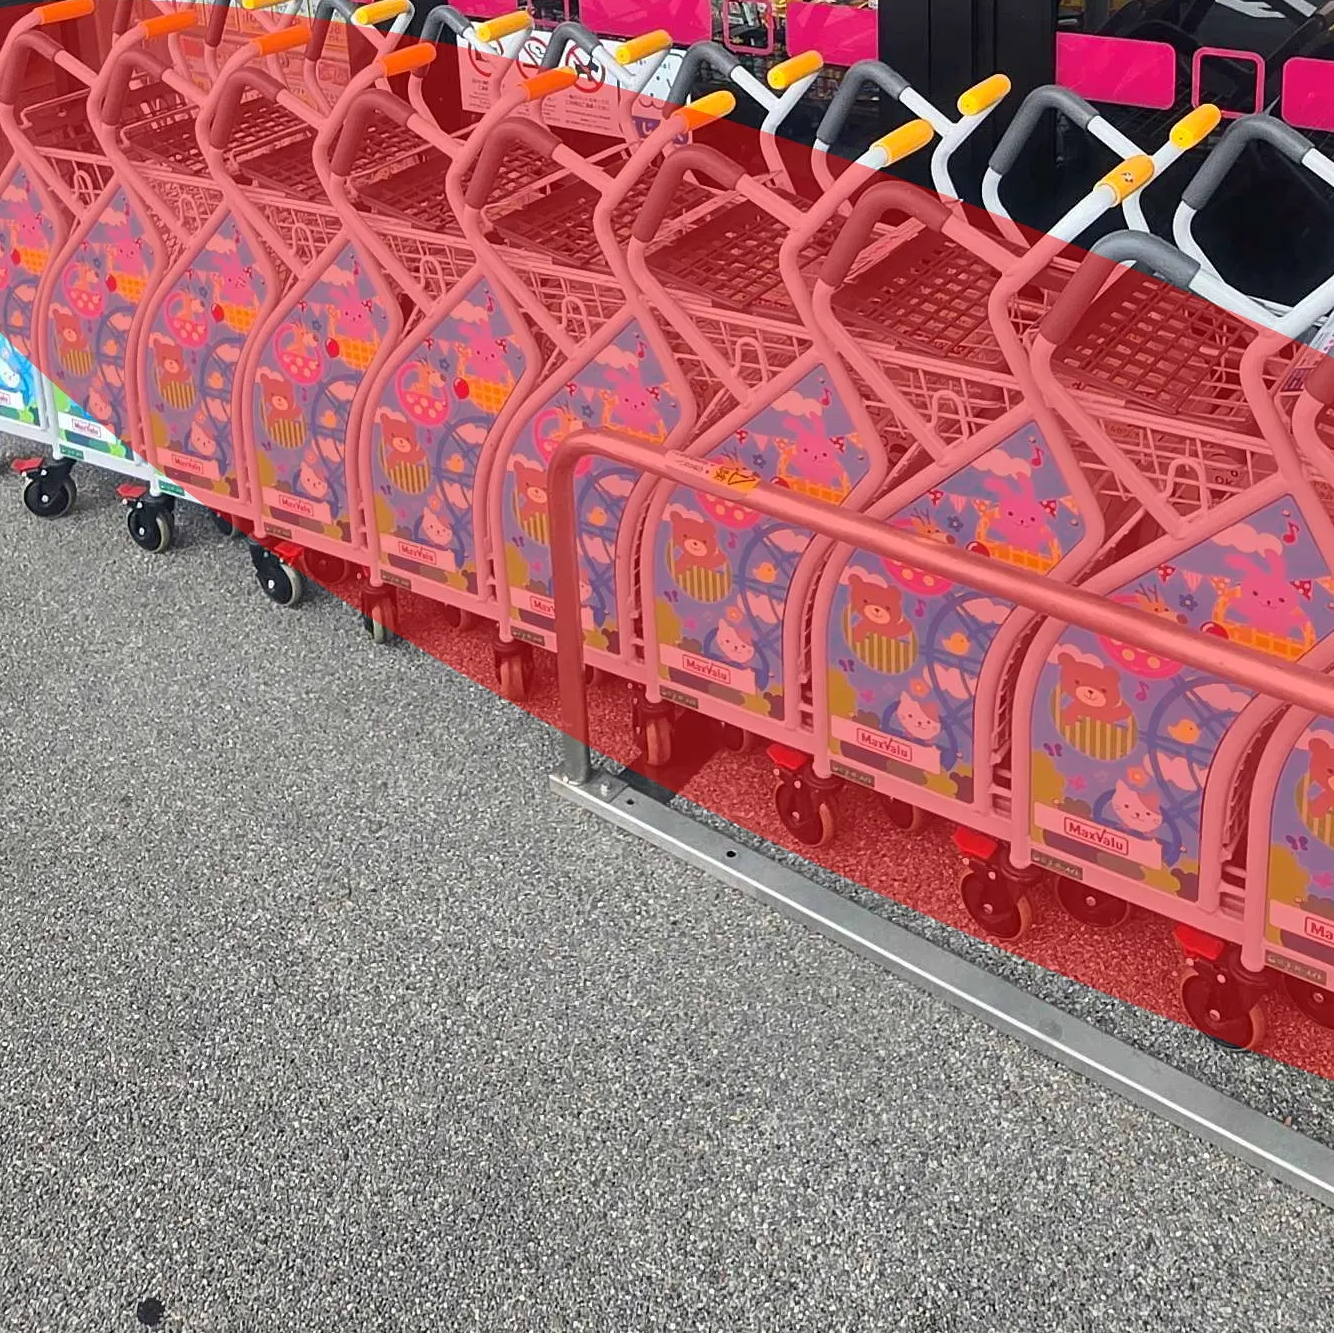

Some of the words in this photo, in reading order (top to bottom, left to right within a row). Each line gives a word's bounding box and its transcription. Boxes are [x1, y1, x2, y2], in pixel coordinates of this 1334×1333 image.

[400, 543, 436, 564] MaxValu
[685, 658, 729, 682] MaxValu
[861, 731, 909, 759] MaxValu
[1067, 821, 1125, 852] MaxValu
